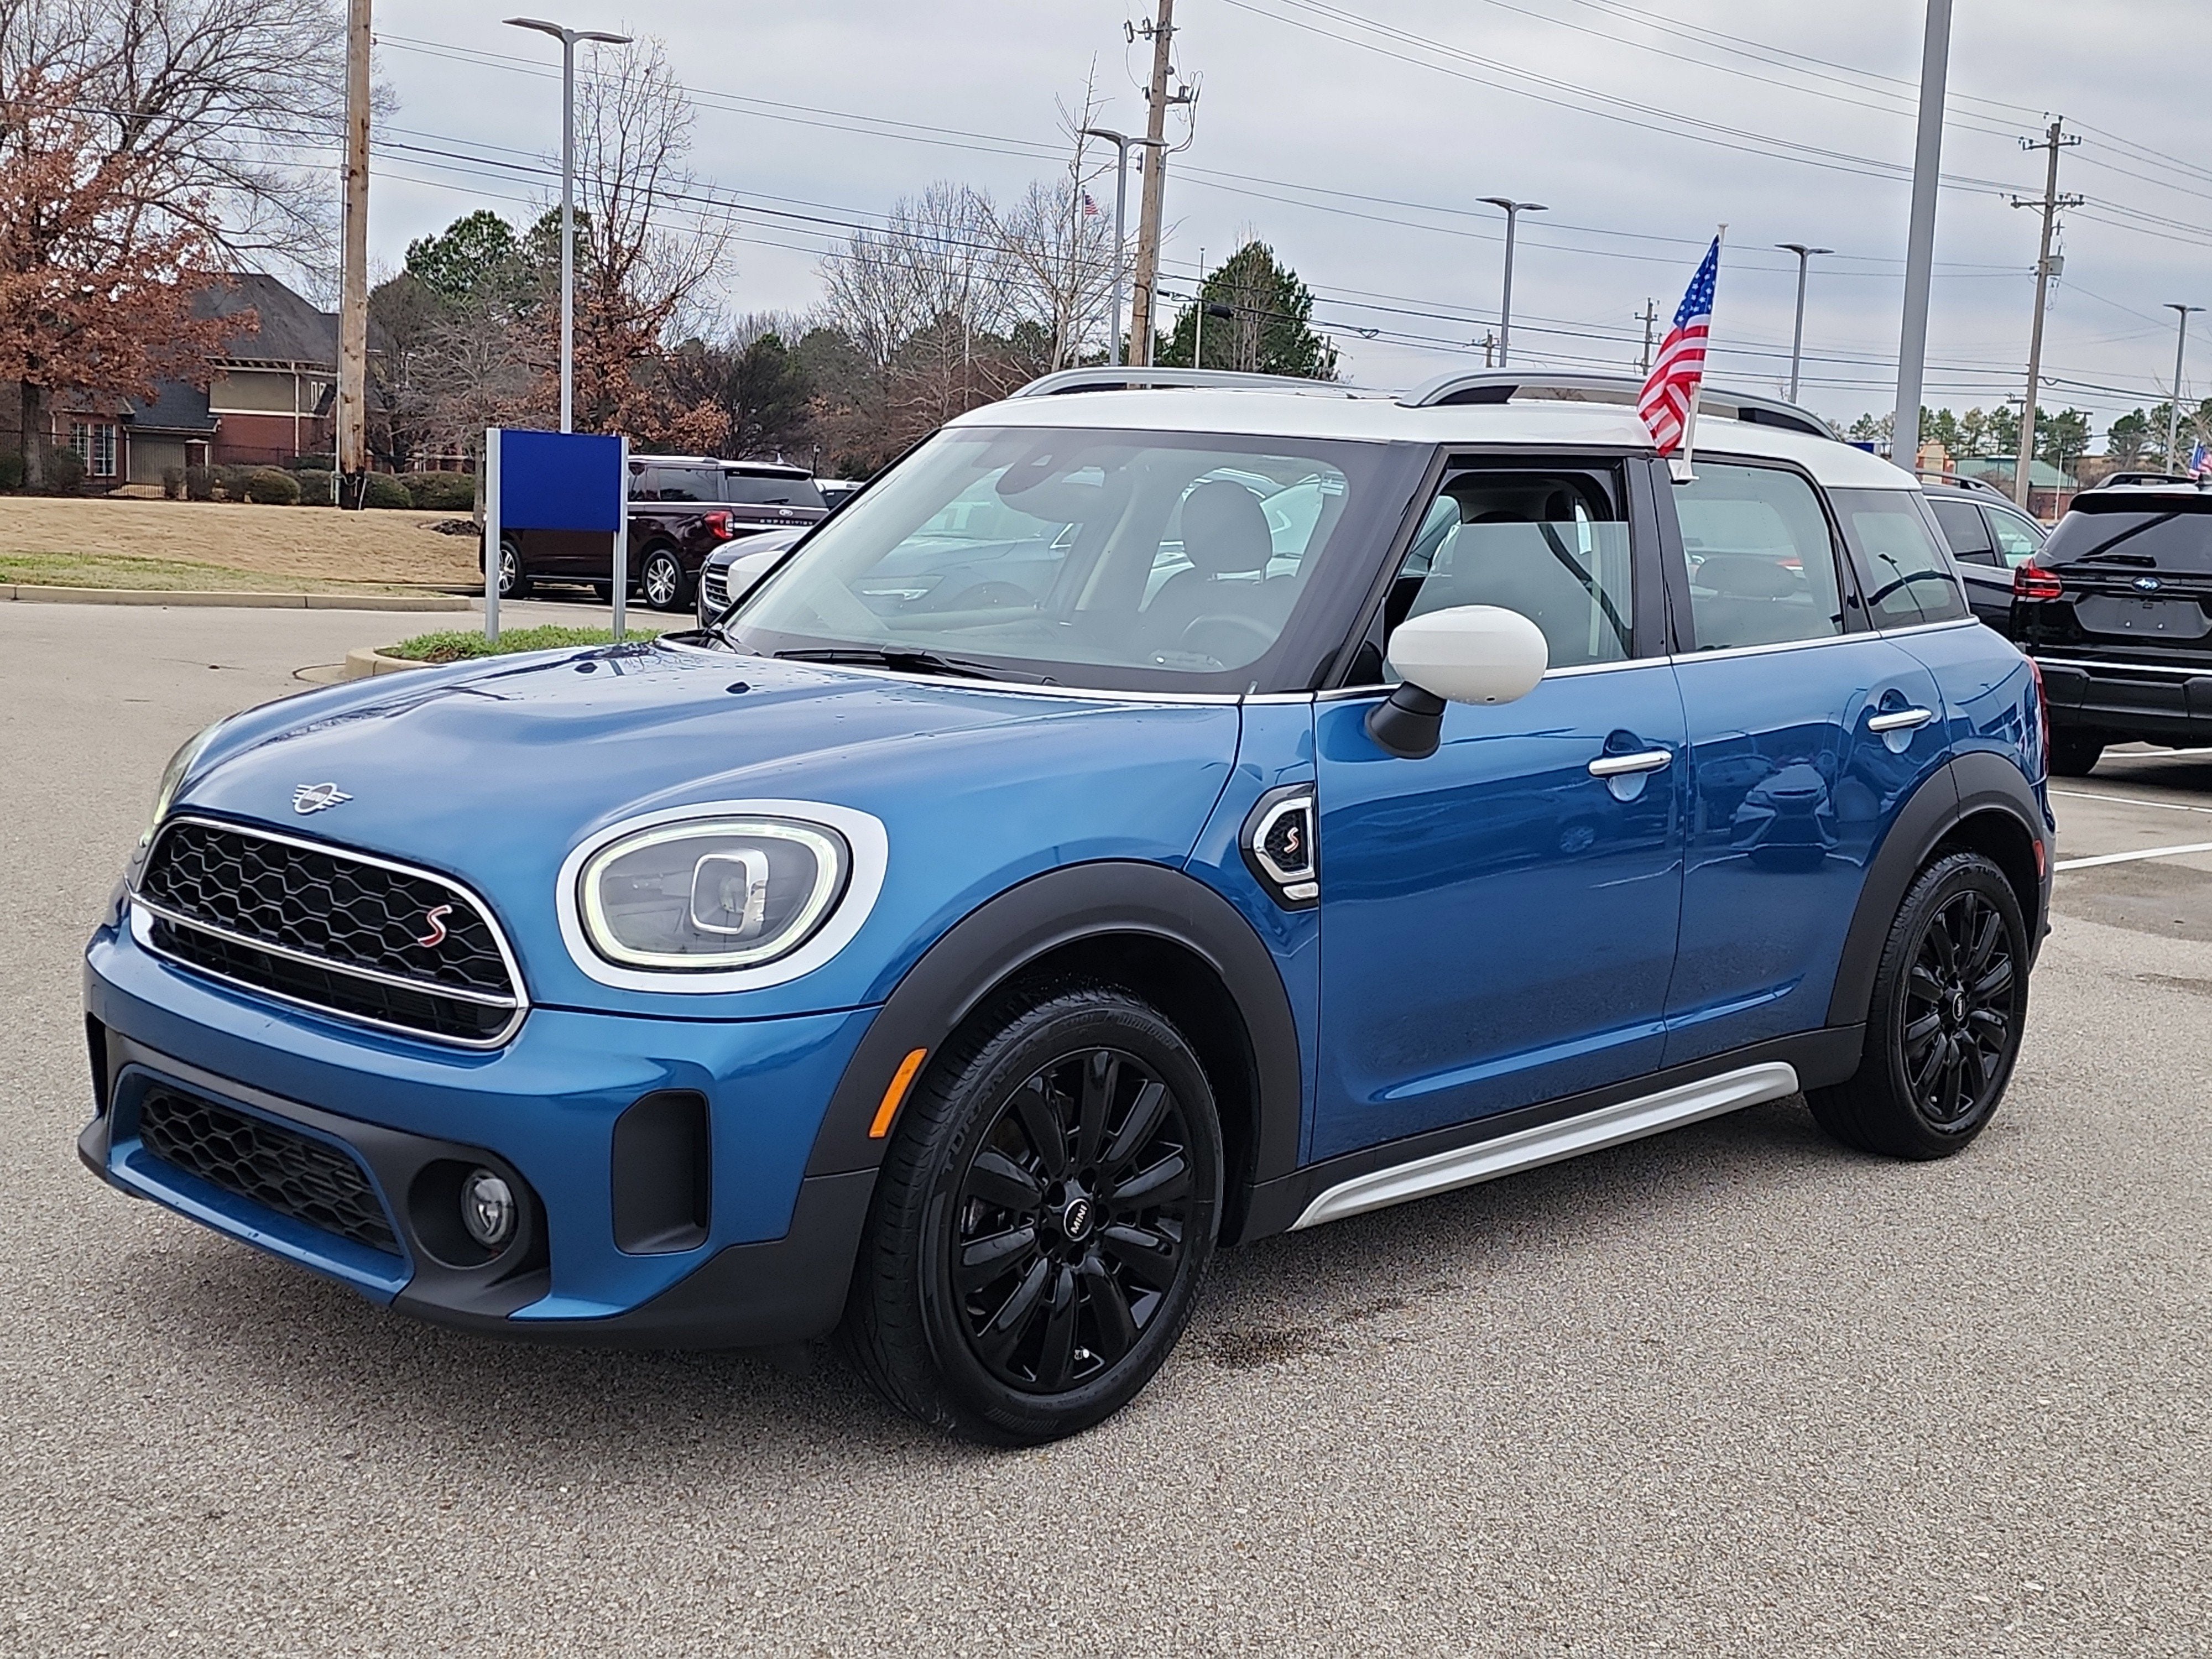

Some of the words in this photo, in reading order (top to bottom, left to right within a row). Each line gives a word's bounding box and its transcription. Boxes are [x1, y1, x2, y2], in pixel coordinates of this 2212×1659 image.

[1284, 827, 1299, 853] S
[418, 904, 453, 948] S
[1070, 1204, 1088, 1234] MINI
